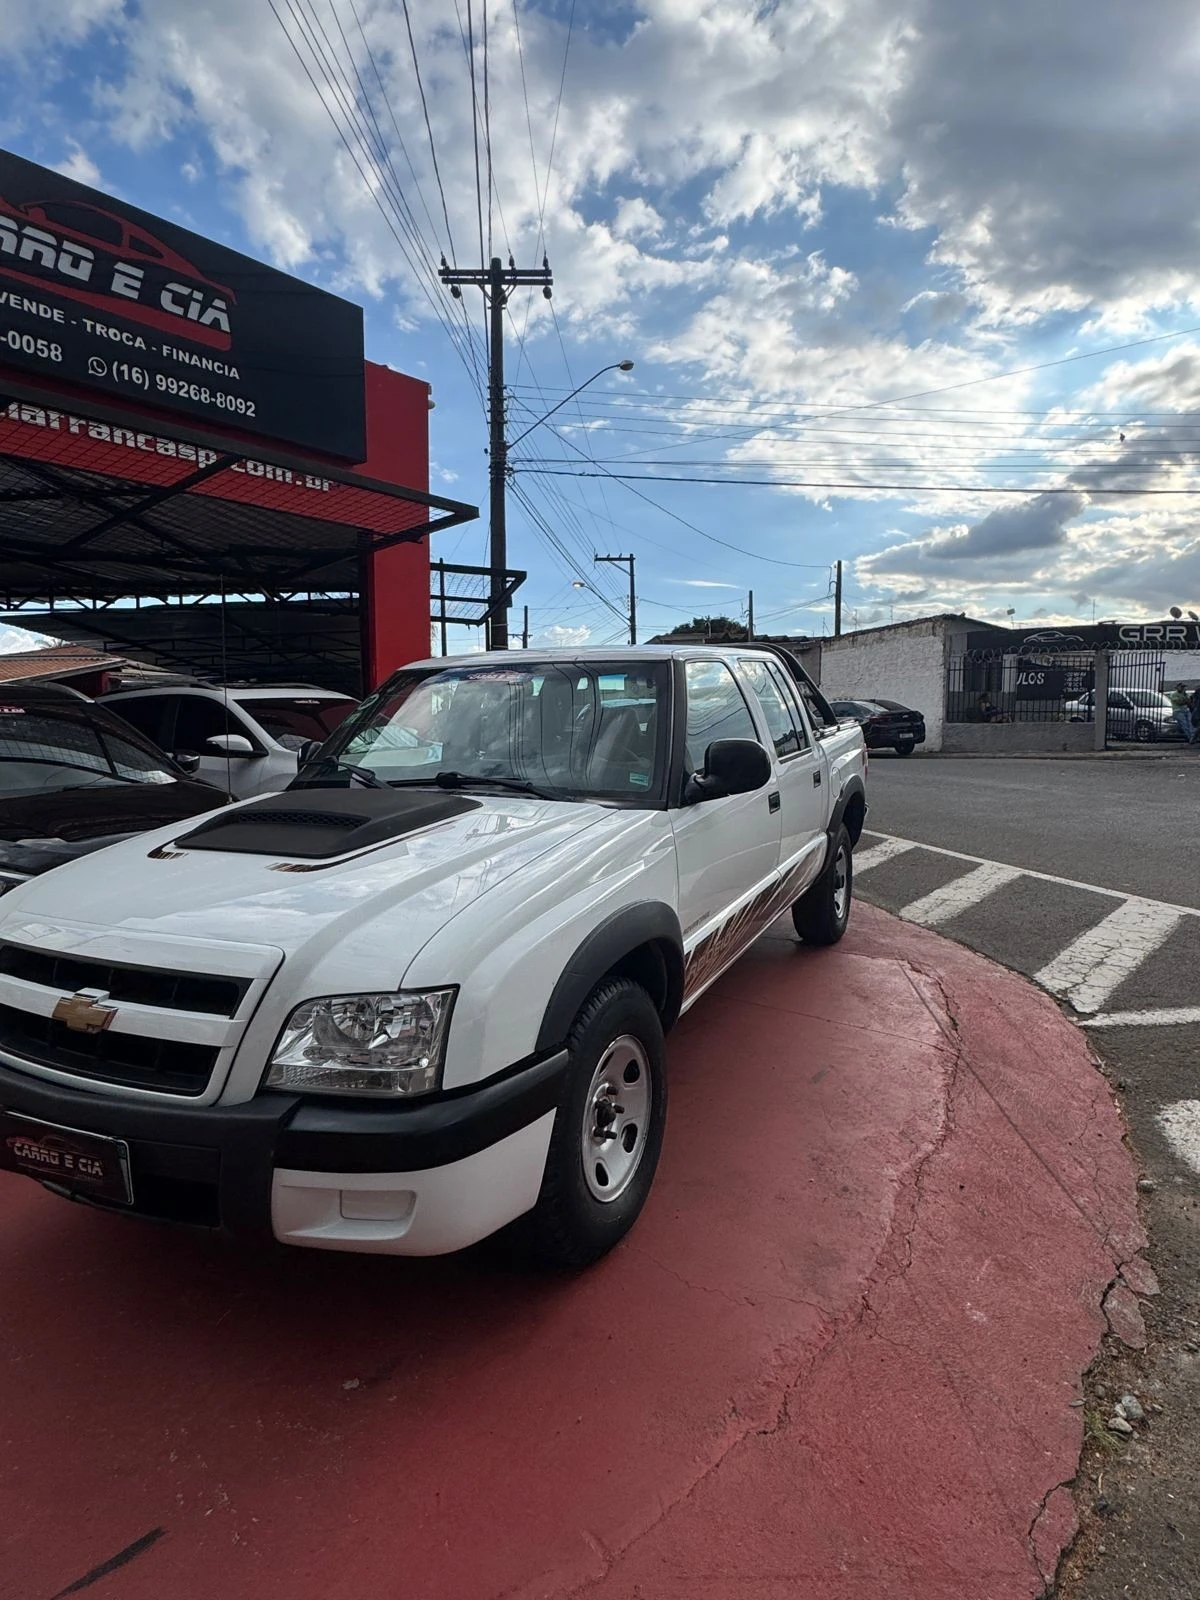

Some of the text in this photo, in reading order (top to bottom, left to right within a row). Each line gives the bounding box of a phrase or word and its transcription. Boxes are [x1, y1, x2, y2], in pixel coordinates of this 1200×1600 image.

[110, 262, 146, 300] E
[160, 281, 231, 333] CIA
[82, 318, 147, 351] TROCA
[162, 345, 240, 380] FINANCIA
[112, 360, 150, 390] (16)
[156, 374, 256, 418] 99268-8092
[1119, 625, 1188, 643] GRR
[65, 1155, 74, 1168] E
[79, 1157, 104, 1177] CIA
